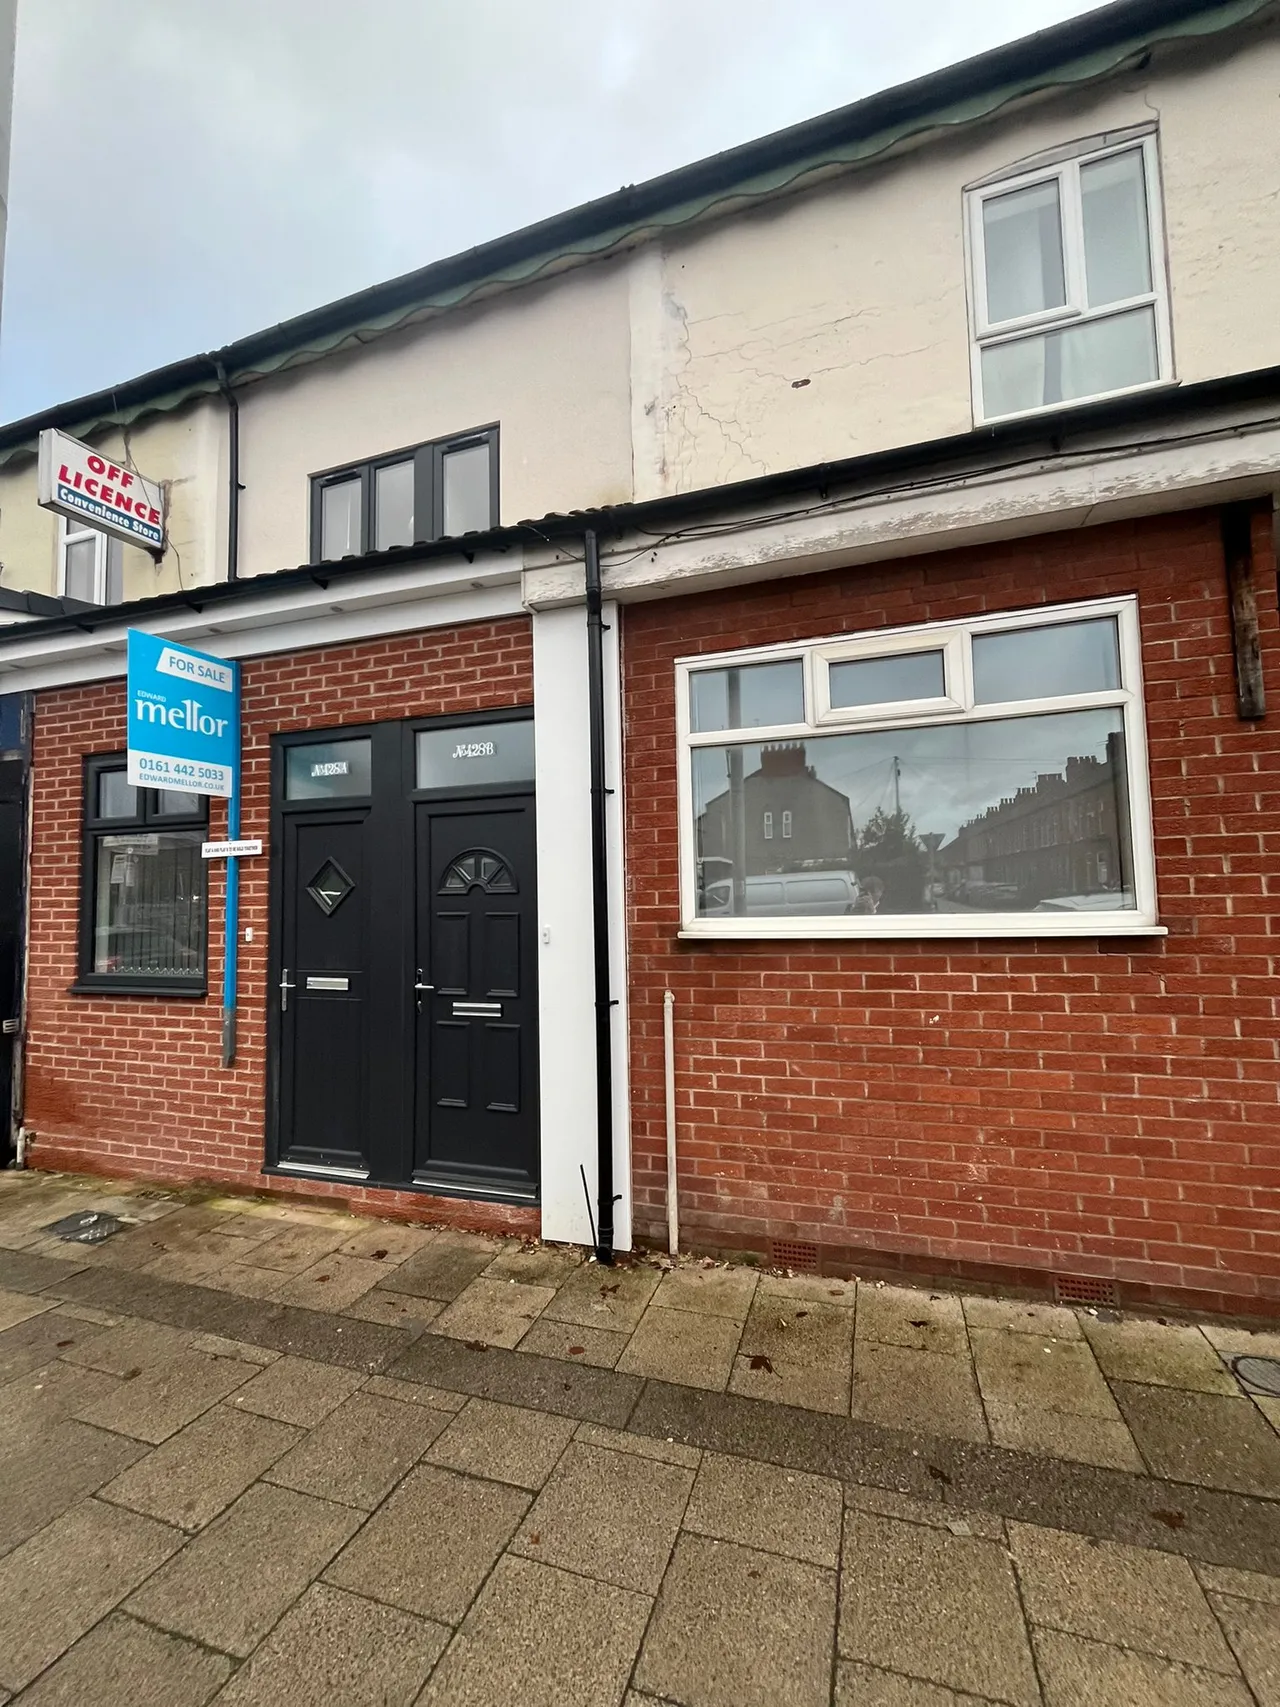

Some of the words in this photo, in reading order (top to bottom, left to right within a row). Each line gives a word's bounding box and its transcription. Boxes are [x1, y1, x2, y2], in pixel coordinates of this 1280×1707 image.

[87, 455, 134, 488] OFF
[58, 464, 161, 525] LICENCE
[60, 487, 130, 528] Convenience
[132, 520, 160, 541] Store
[169, 656, 195, 674] FOR
[198, 665, 226, 683] SALE
[137, 689, 167, 702] EDWARD
[134, 699, 229, 737] mellor
[138, 772, 225, 791] EDWARDMELLOR.CO.UK
[139, 757, 170, 773] 0161
[173, 763, 196, 777] 442
[198, 767, 225, 781] 5033
